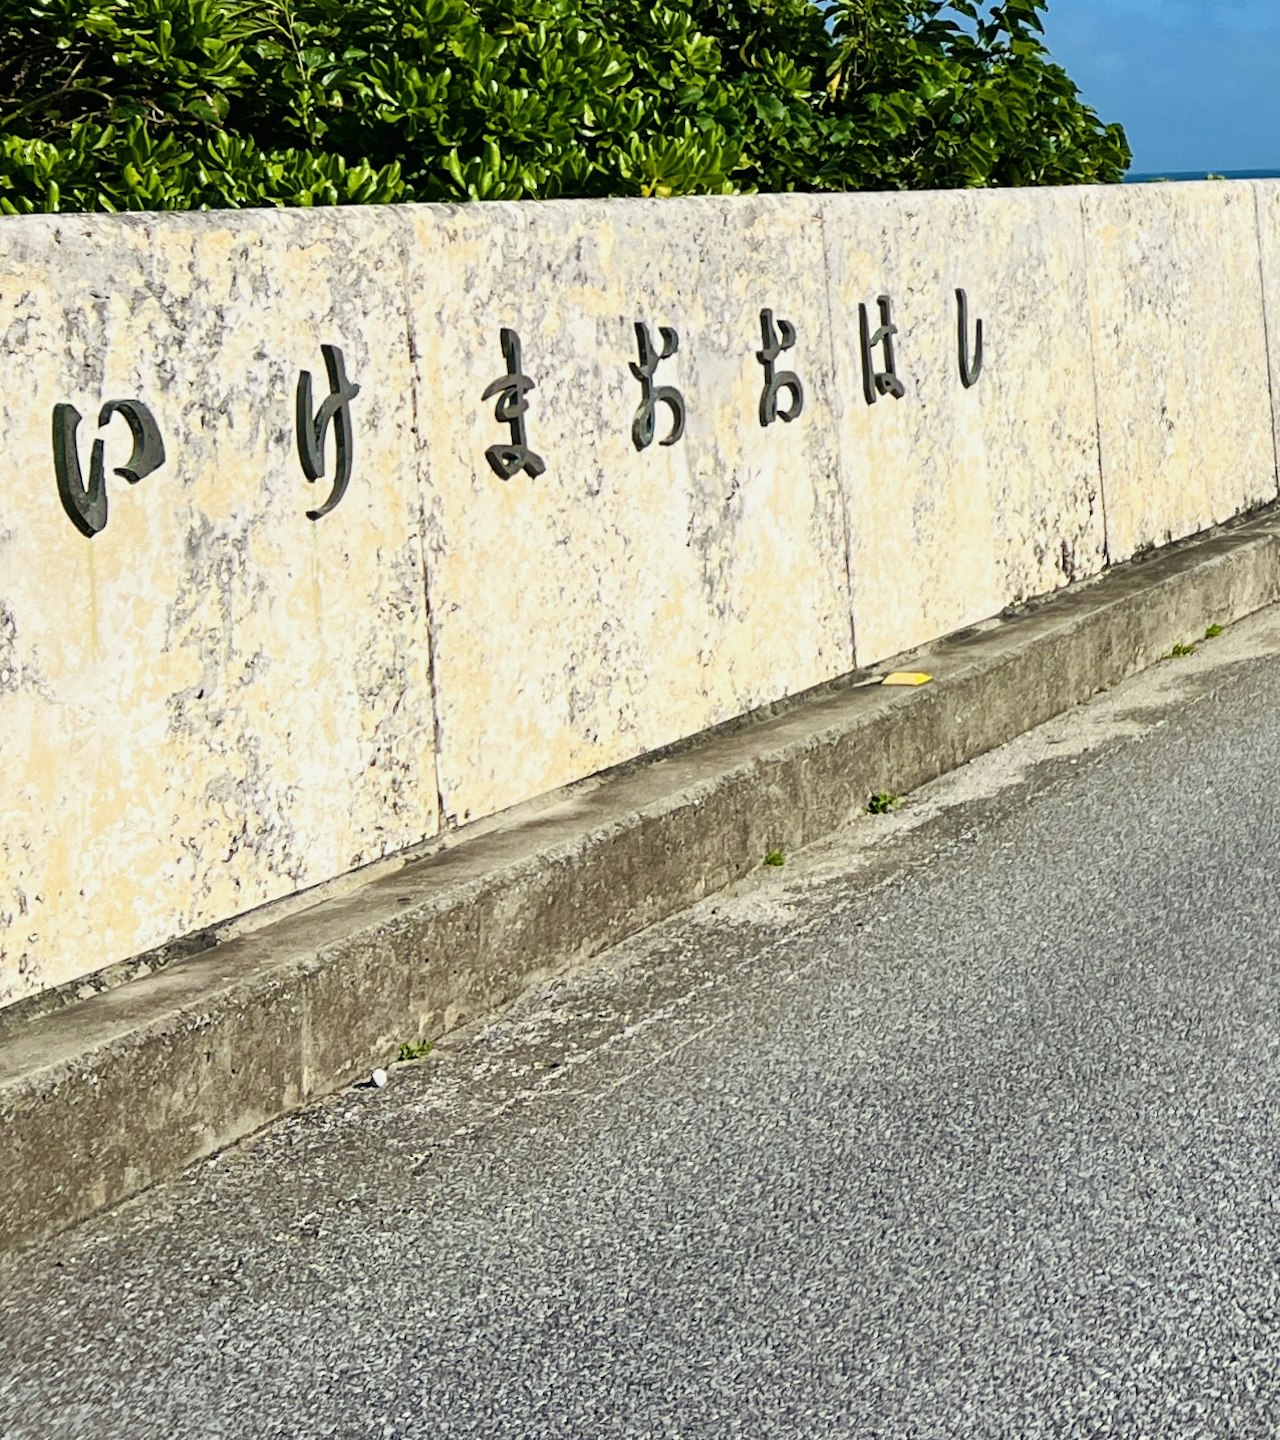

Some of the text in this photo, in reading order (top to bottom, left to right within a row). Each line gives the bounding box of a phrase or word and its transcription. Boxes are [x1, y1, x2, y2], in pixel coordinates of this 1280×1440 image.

[52, 288, 982, 538] いけまおおはし
